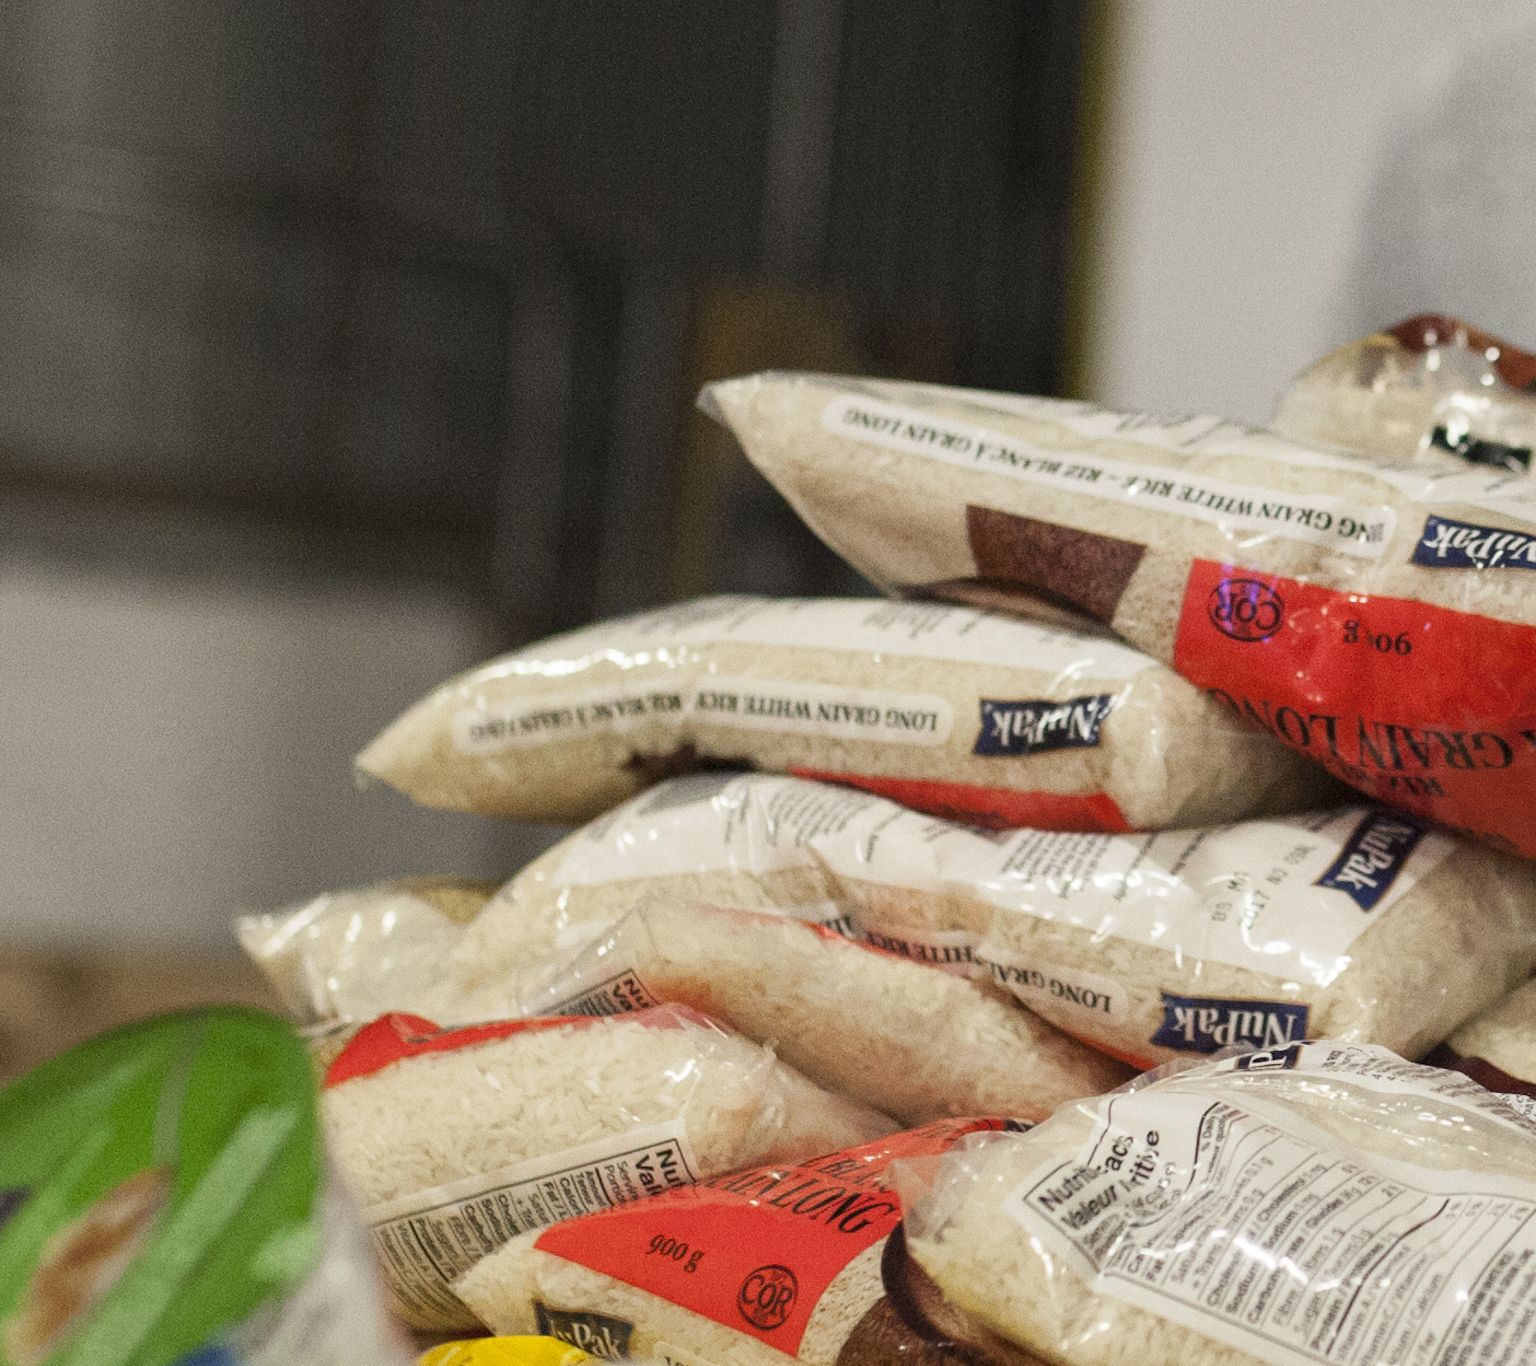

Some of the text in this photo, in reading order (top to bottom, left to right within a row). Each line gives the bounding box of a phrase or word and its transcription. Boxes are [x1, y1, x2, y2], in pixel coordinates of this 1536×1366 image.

[841, 404, 901, 436] LONG
[904, 419, 972, 452] GRAIN
[989, 444, 1061, 475] BLANC
[1064, 461, 1101, 485] RIZ
[1125, 473, 1175, 502] RICE
[1180, 482, 1255, 516] WHITE
[1258, 498, 1332, 538] GRAIN
[743, 694, 812, 720] WHITE
[816, 702, 880, 726] GRAIN
[884, 708, 938, 732] LONG
[1206, 686, 1340, 758] LONG
[1358, 715, 1515, 773] GRAIN
[1063, 981, 1113, 1015] LONG
[1171, 1004, 1297, 1049] NuPak
[542, 1180, 561, 1204] Fat
[778, 1169, 898, 1235] LONG
[645, 1233, 706, 1274] 900 g
[741, 1273, 795, 1322] COR
[1408, 1271, 1445, 1320] Calcium
